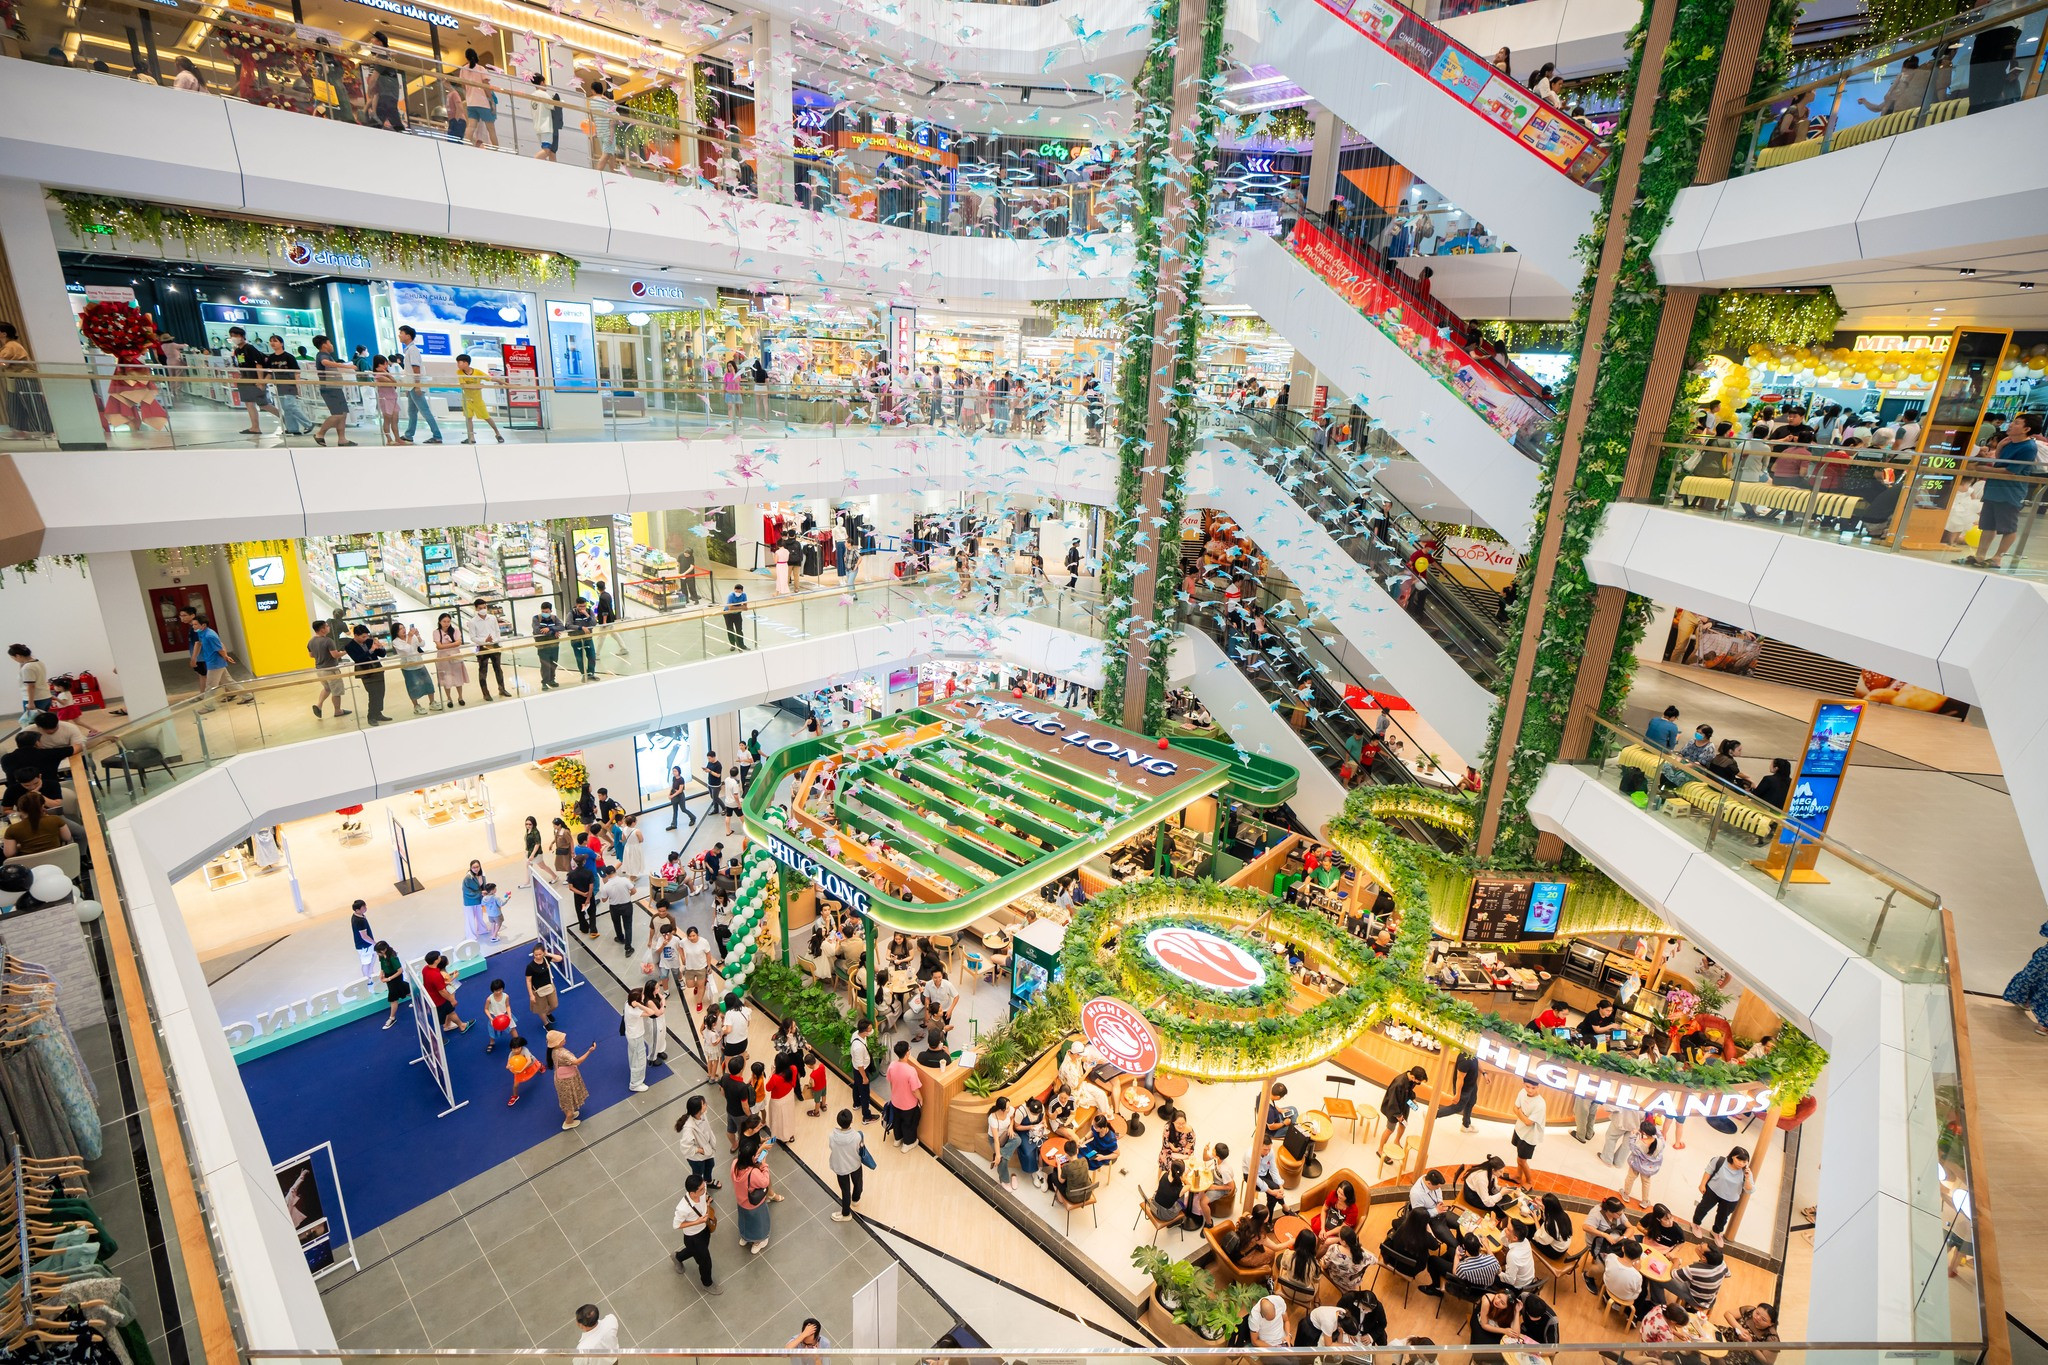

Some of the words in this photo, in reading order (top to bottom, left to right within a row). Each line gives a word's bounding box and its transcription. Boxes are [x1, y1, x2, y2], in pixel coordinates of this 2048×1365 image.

[1040, 143, 1068, 160] City
[313, 250, 371, 269] elmich
[1302, 243, 1325, 269] Phong
[647, 284, 684, 299] elmich
[563, 308, 584, 318] elmich
[1927, 456, 1956, 469] 10%
[1061, 730, 1179, 778] LONG
[767, 834, 813, 879] PHUC
[815, 865, 869, 914] LONG
[1087, 1003, 1153, 1053] HIGHLANDS
[1092, 1036, 1143, 1072] COFFEE
[1476, 1036, 1773, 1117] HIGHLANDS
